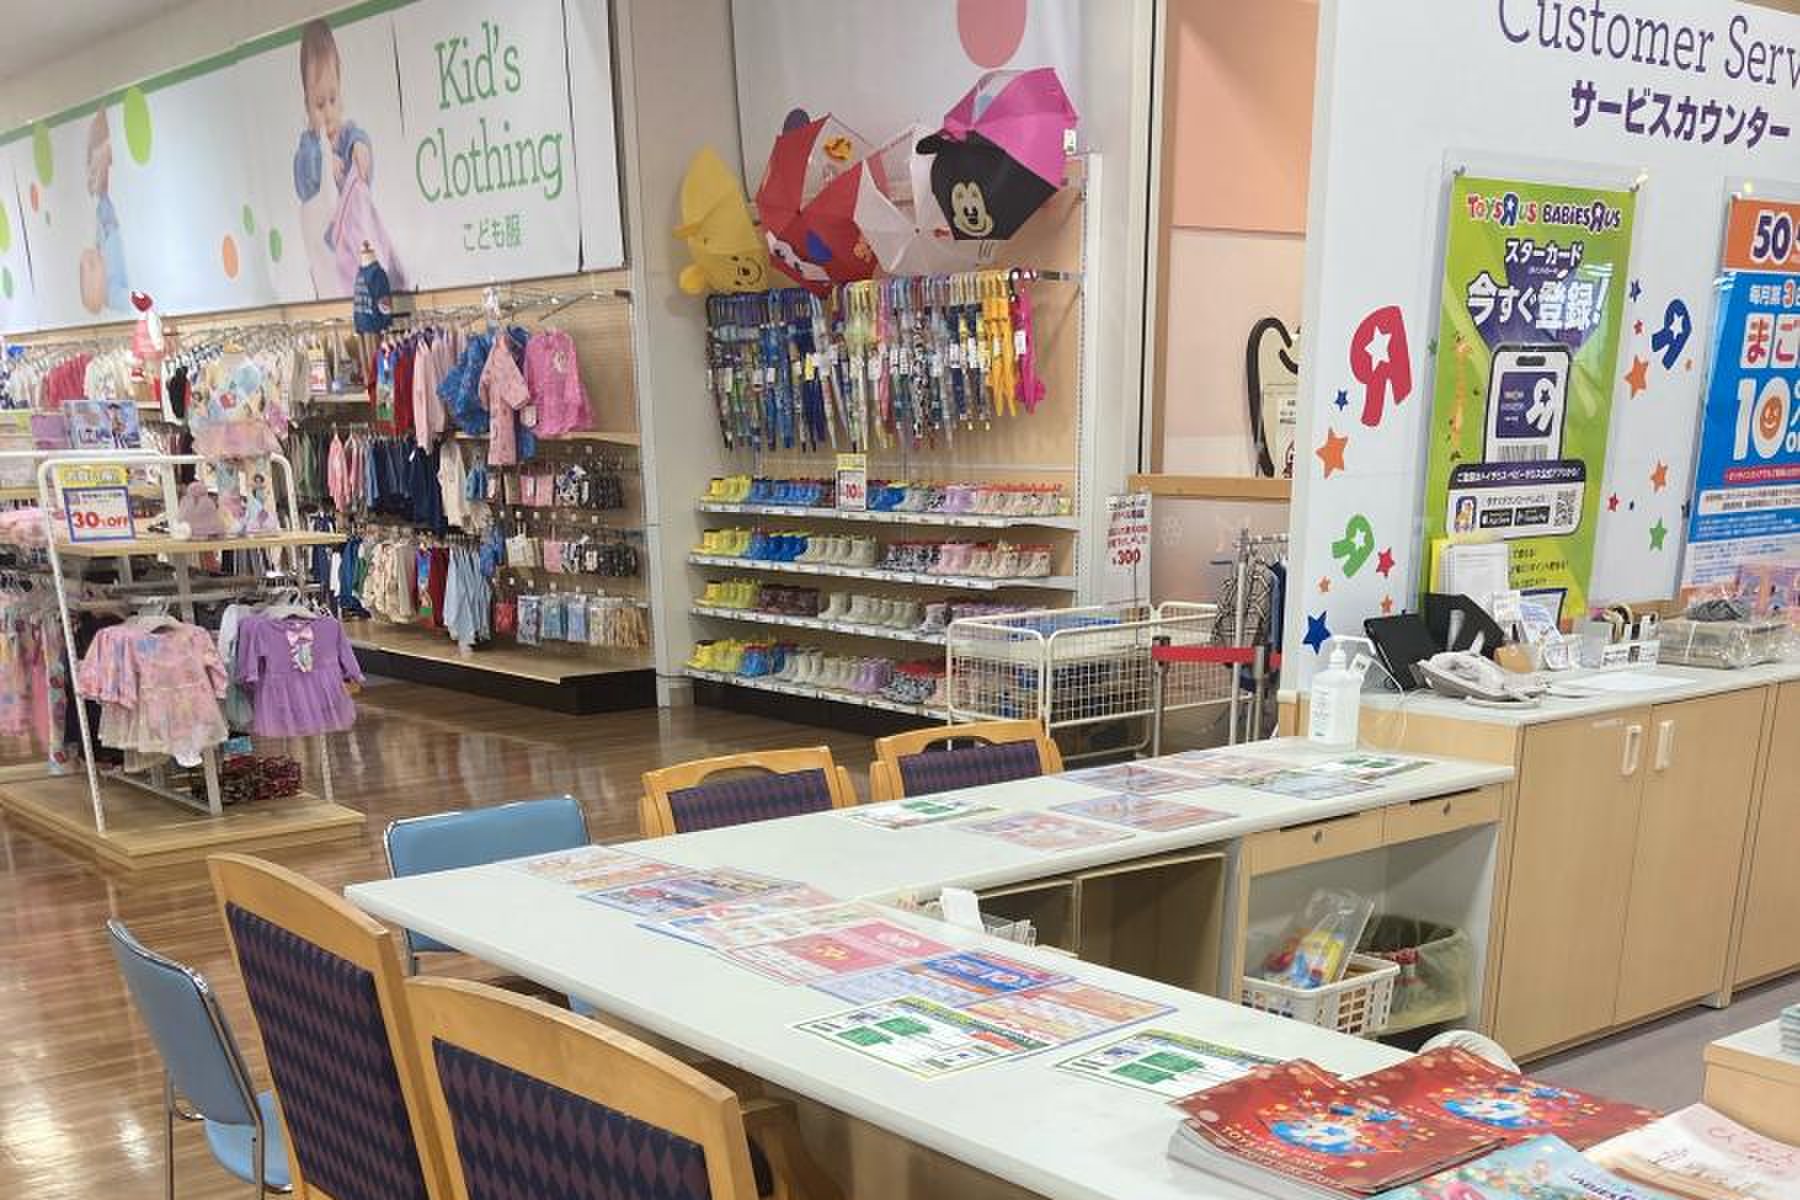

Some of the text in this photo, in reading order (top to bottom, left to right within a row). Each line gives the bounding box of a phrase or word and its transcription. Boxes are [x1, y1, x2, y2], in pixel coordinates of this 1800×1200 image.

[434, 20, 522, 111] Kid's
[1499, 0, 1714, 73] Customer
[1571, 79, 1791, 149] サービスカウンター
[415, 117, 564, 203] Clothing
[1504, 239, 1584, 268] スターカード
[1752, 211, 1800, 262] 50
